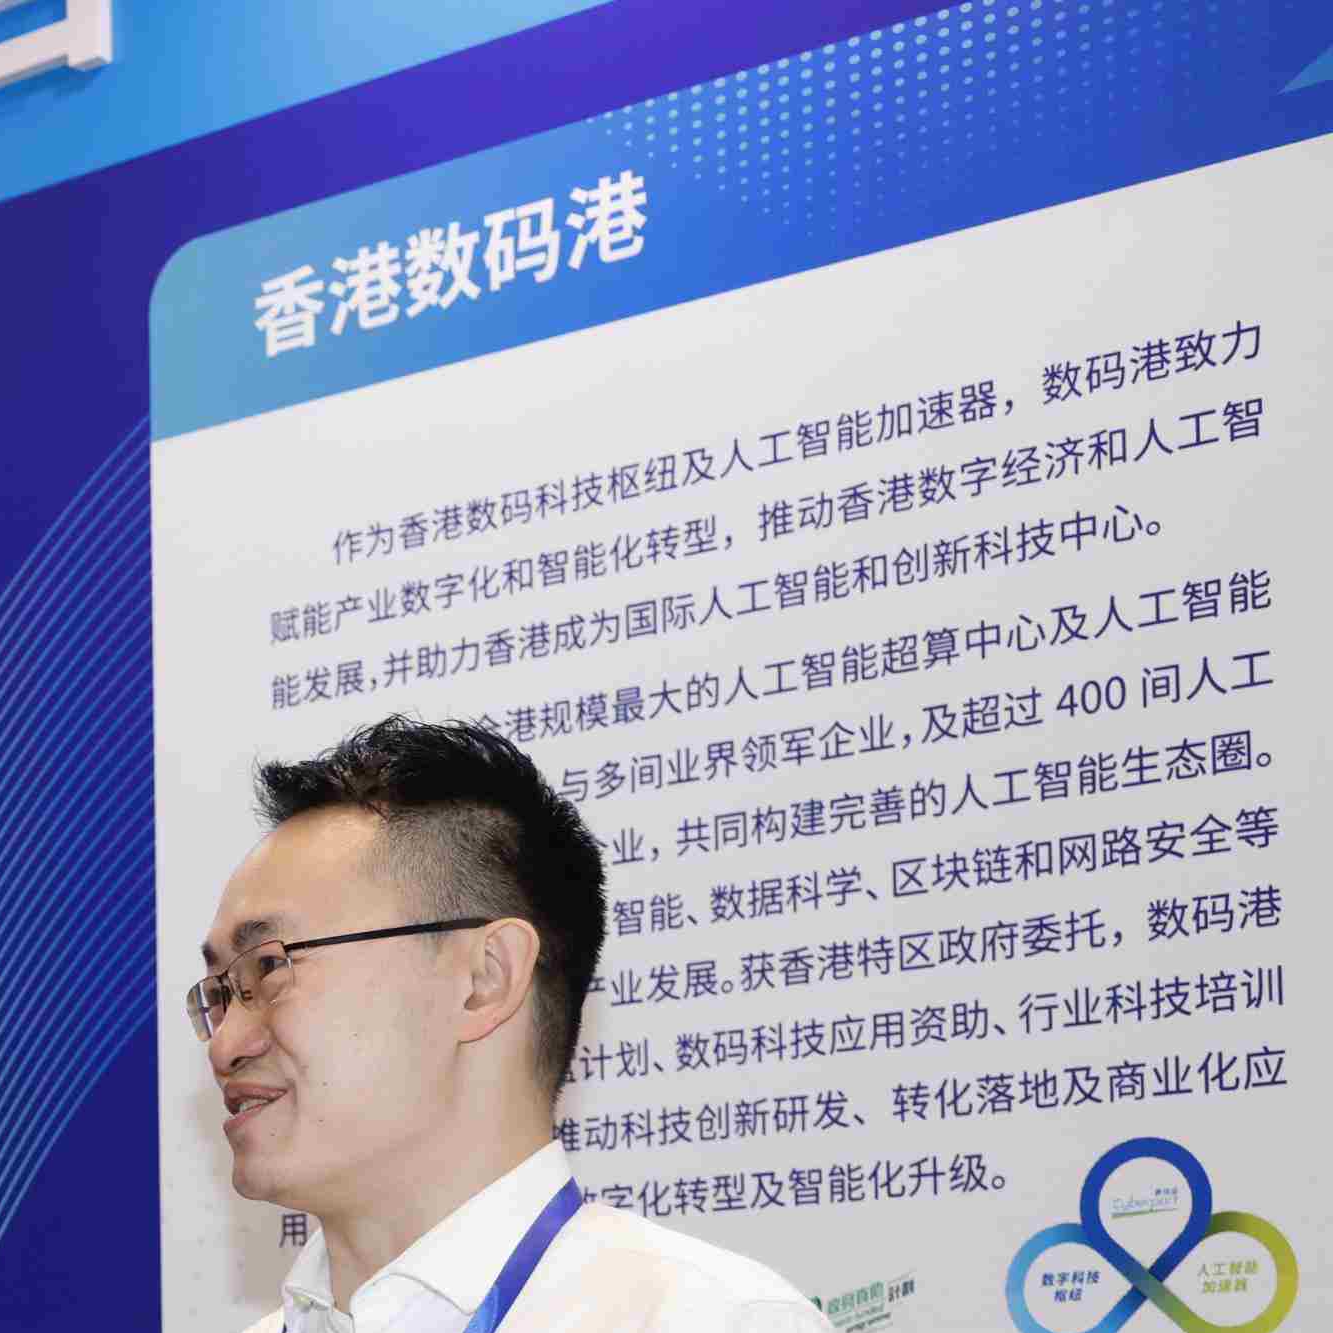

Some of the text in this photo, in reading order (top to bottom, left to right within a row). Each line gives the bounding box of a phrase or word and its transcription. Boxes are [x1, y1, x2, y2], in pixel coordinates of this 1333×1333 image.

[253, 171, 649, 357] 香港数码港
[333, 319, 1264, 567] 作为香港数码科技枢纽及人工智能加速器，数码港致力
[270, 396, 1265, 646] 赋能产业数字化和智能化转型，推动香港数字经济和人工智
[1056, 676, 1127, 721] 400
[1140, 650, 1274, 709] 间人工
[595, 731, 1274, 865] 业，共同构建完善的人工智能生态圈。
[565, 966, 1285, 1082] 计划、数码科技应用资助、行业科技培训
[279, 1213, 307, 1248] 用
[1041, 1269, 1101, 1287] 数字科技
